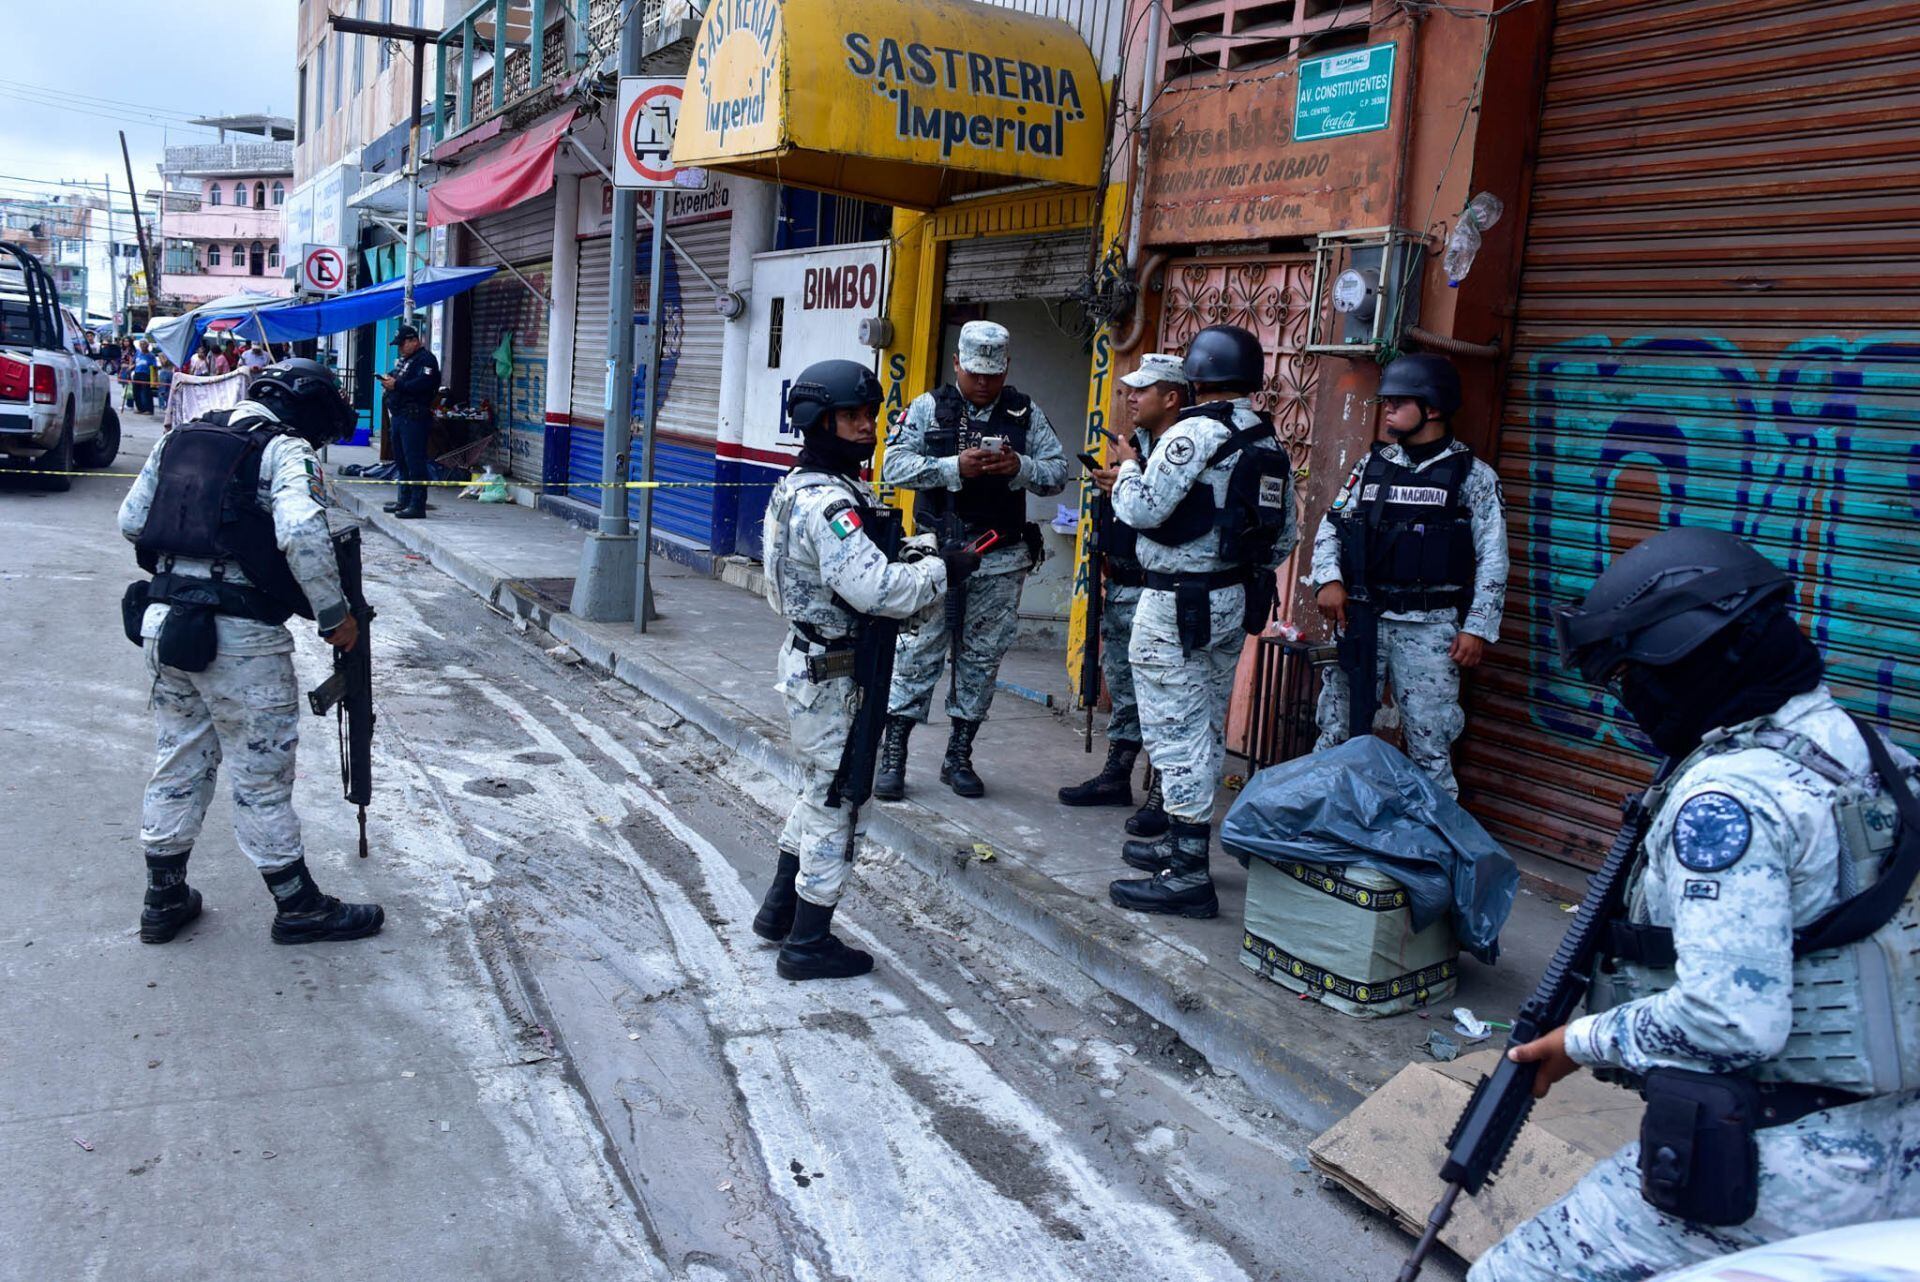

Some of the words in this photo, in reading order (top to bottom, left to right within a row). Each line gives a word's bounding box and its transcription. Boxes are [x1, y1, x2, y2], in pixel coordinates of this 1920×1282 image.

[845, 33, 1082, 109] SASTRERIA
[1300, 89, 1313, 103] AV.
[1315, 74, 1387, 100] CONSTITUYENTES
[1210, 163, 1249, 189] LUNES
[1264, 154, 1330, 182] SABADO
[803, 263, 877, 309] BIMBO
[1401, 487, 1445, 504] NACIONAL
